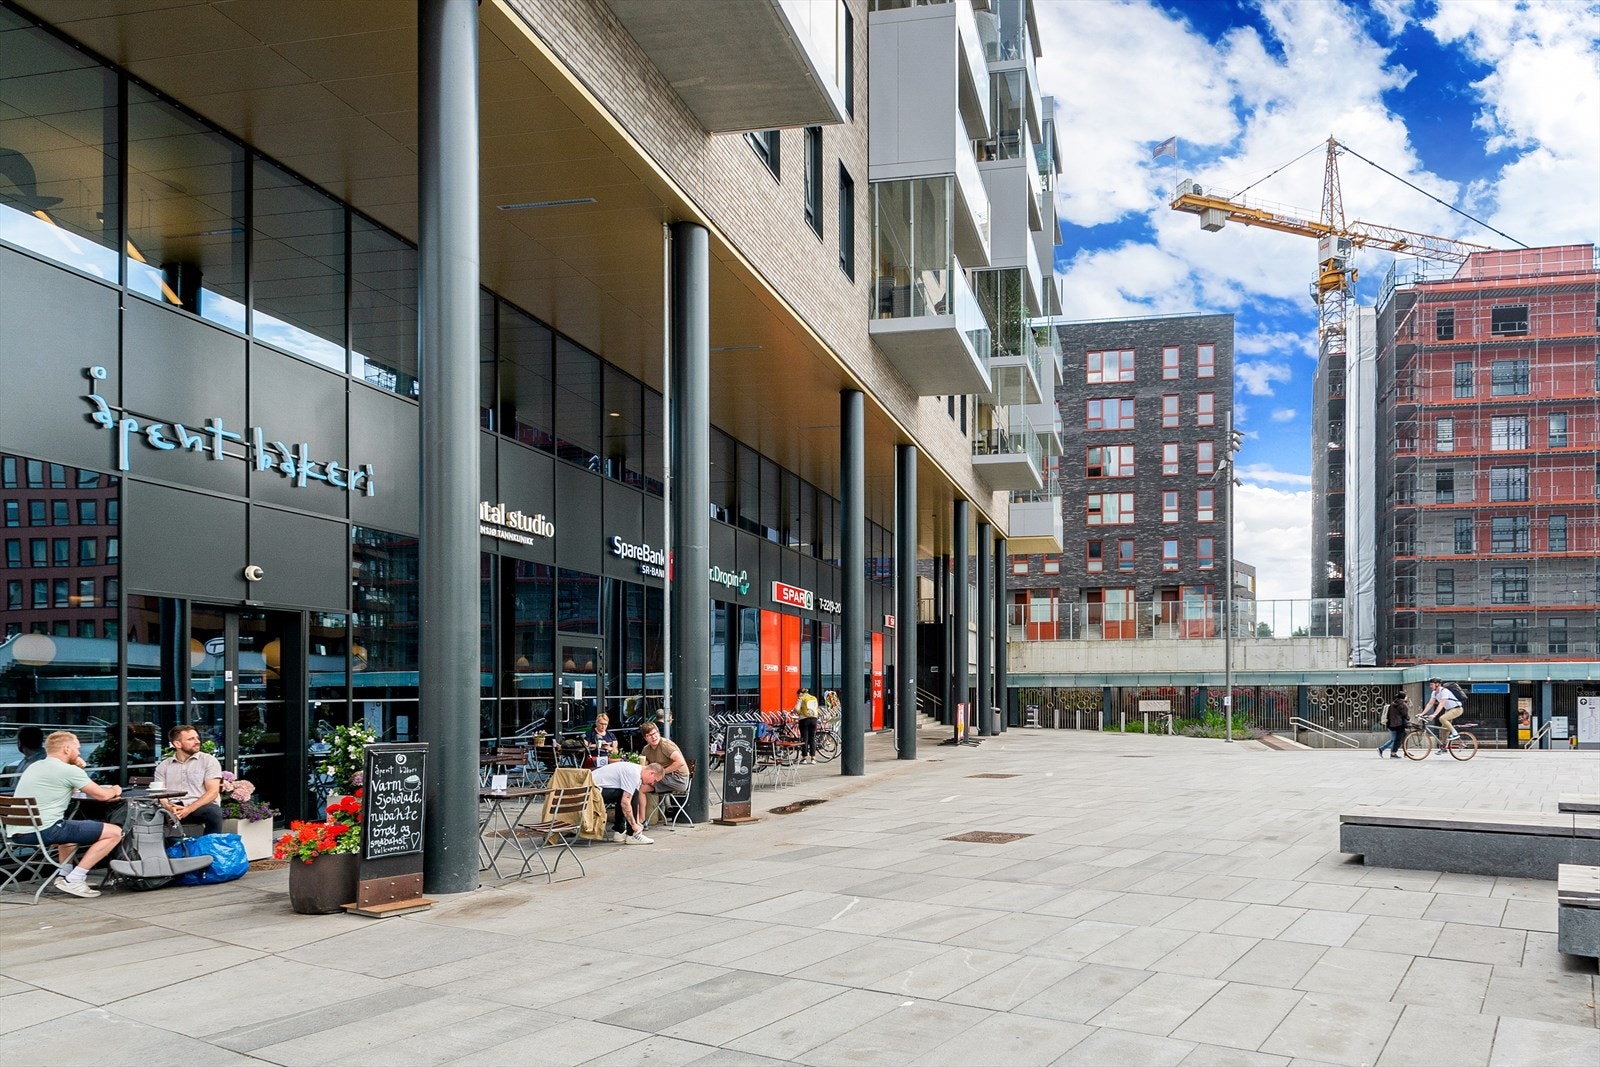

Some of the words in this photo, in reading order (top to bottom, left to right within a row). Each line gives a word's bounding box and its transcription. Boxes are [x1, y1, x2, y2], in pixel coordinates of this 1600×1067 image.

[253, 427, 374, 496] bakeri
[507, 510, 554, 537] studio
[782, 587, 805, 605] SPAR
[371, 779, 402, 792] Varm
[370, 805, 418, 827] nybakte
[372, 824, 398, 837] brød
[400, 825, 411, 836] og
